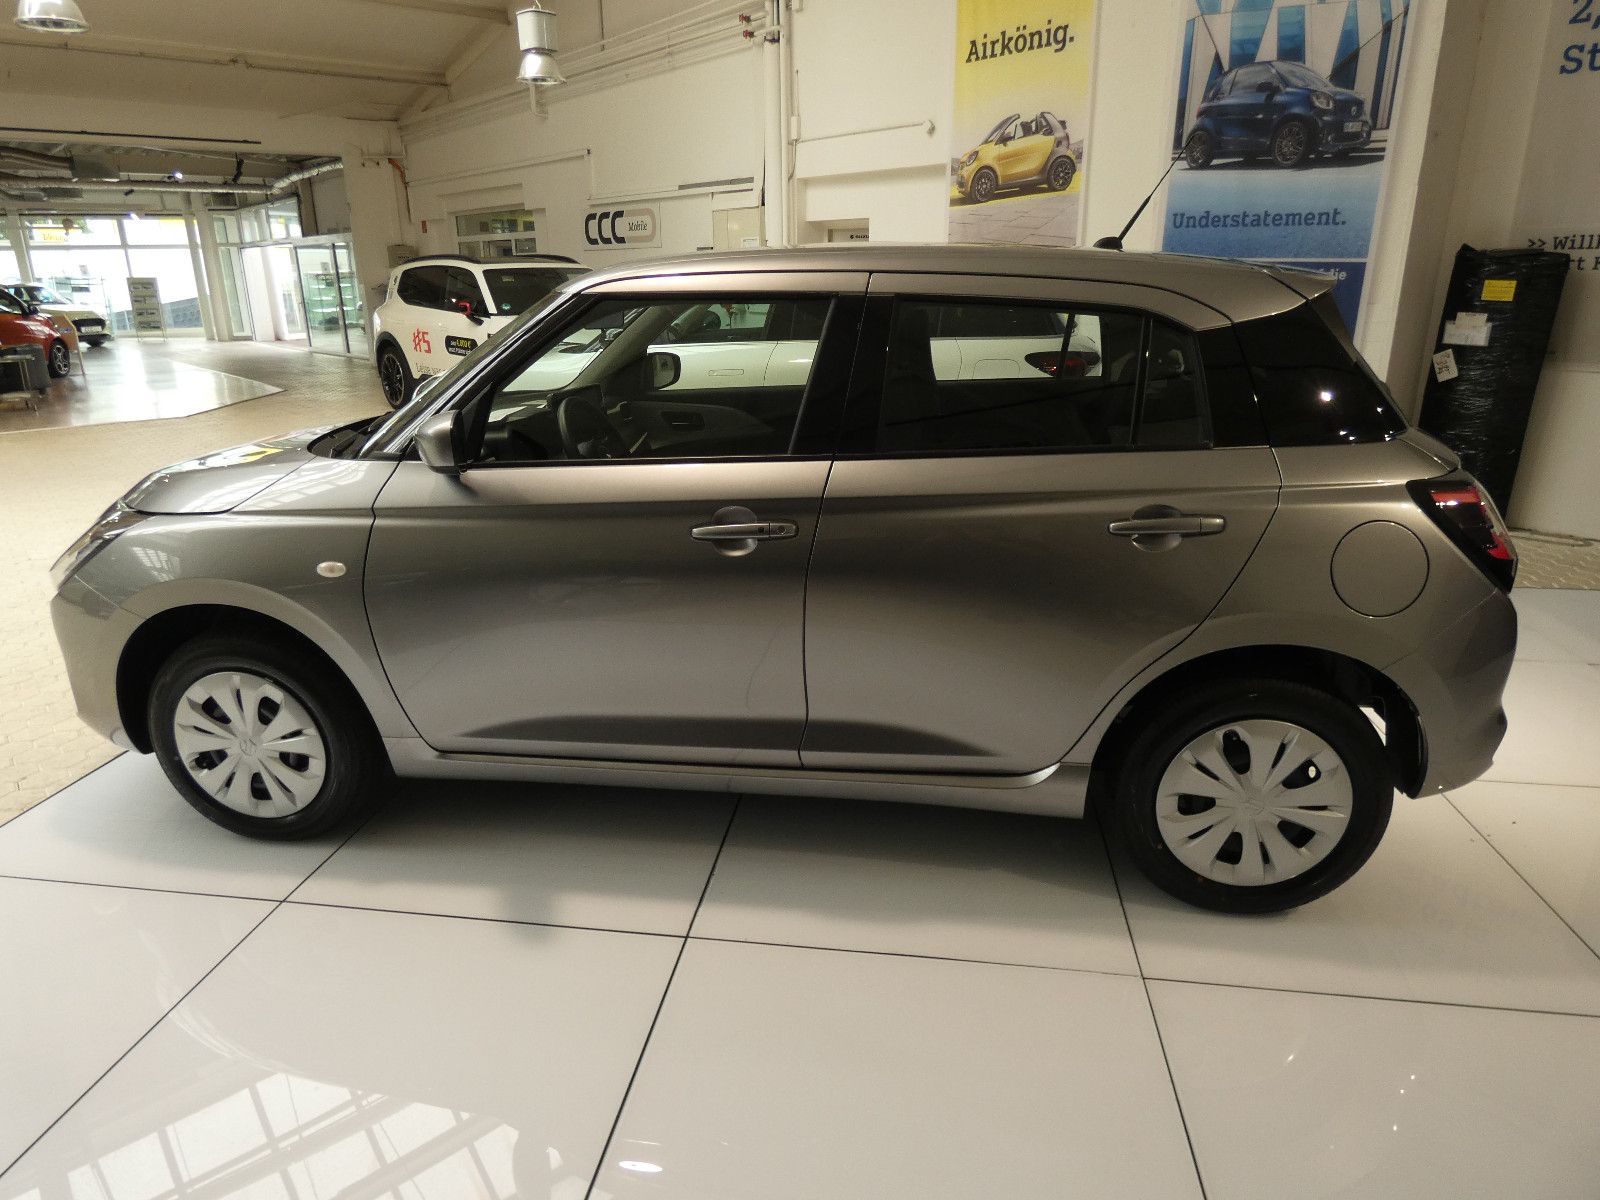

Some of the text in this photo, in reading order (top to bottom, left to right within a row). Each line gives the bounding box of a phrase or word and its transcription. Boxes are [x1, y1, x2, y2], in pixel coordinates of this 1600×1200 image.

[965, 19, 1075, 63] Airkönig.
[1559, 42, 1600, 75] St
[584, 210, 627, 246] CCC
[1172, 208, 1347, 229] Understatement.
